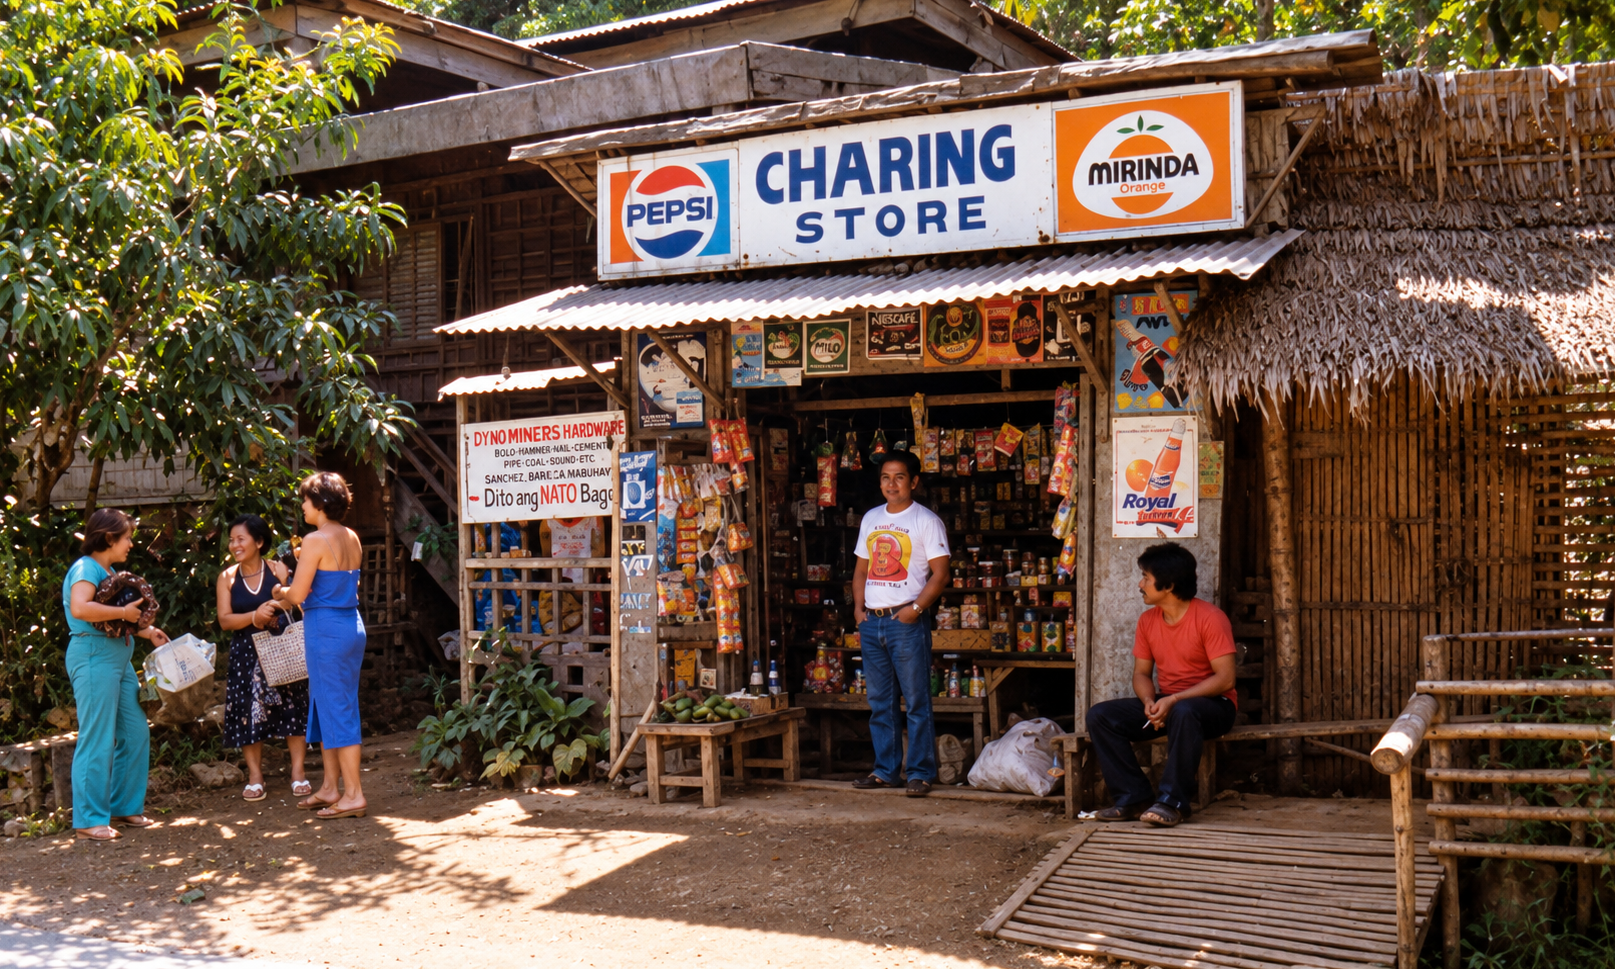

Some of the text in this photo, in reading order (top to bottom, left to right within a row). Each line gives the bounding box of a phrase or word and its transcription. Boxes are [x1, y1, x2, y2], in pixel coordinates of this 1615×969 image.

[755, 124, 1016, 205] CHARING
[1088, 152, 1200, 186] MIRINDA
[1120, 181, 1166, 194] Orange
[627, 196, 713, 228] PEPSI
[794, 195, 987, 243] STORE
[508, 425, 561, 444] MINERS
[563, 419, 625, 440] HARDWARE
[567, 467, 612, 479] MABUHAY
[484, 488, 514, 508] Dito
[516, 491, 538, 512] ang
[540, 482, 578, 505] NATO
[1122, 493, 1177, 512] Royal
